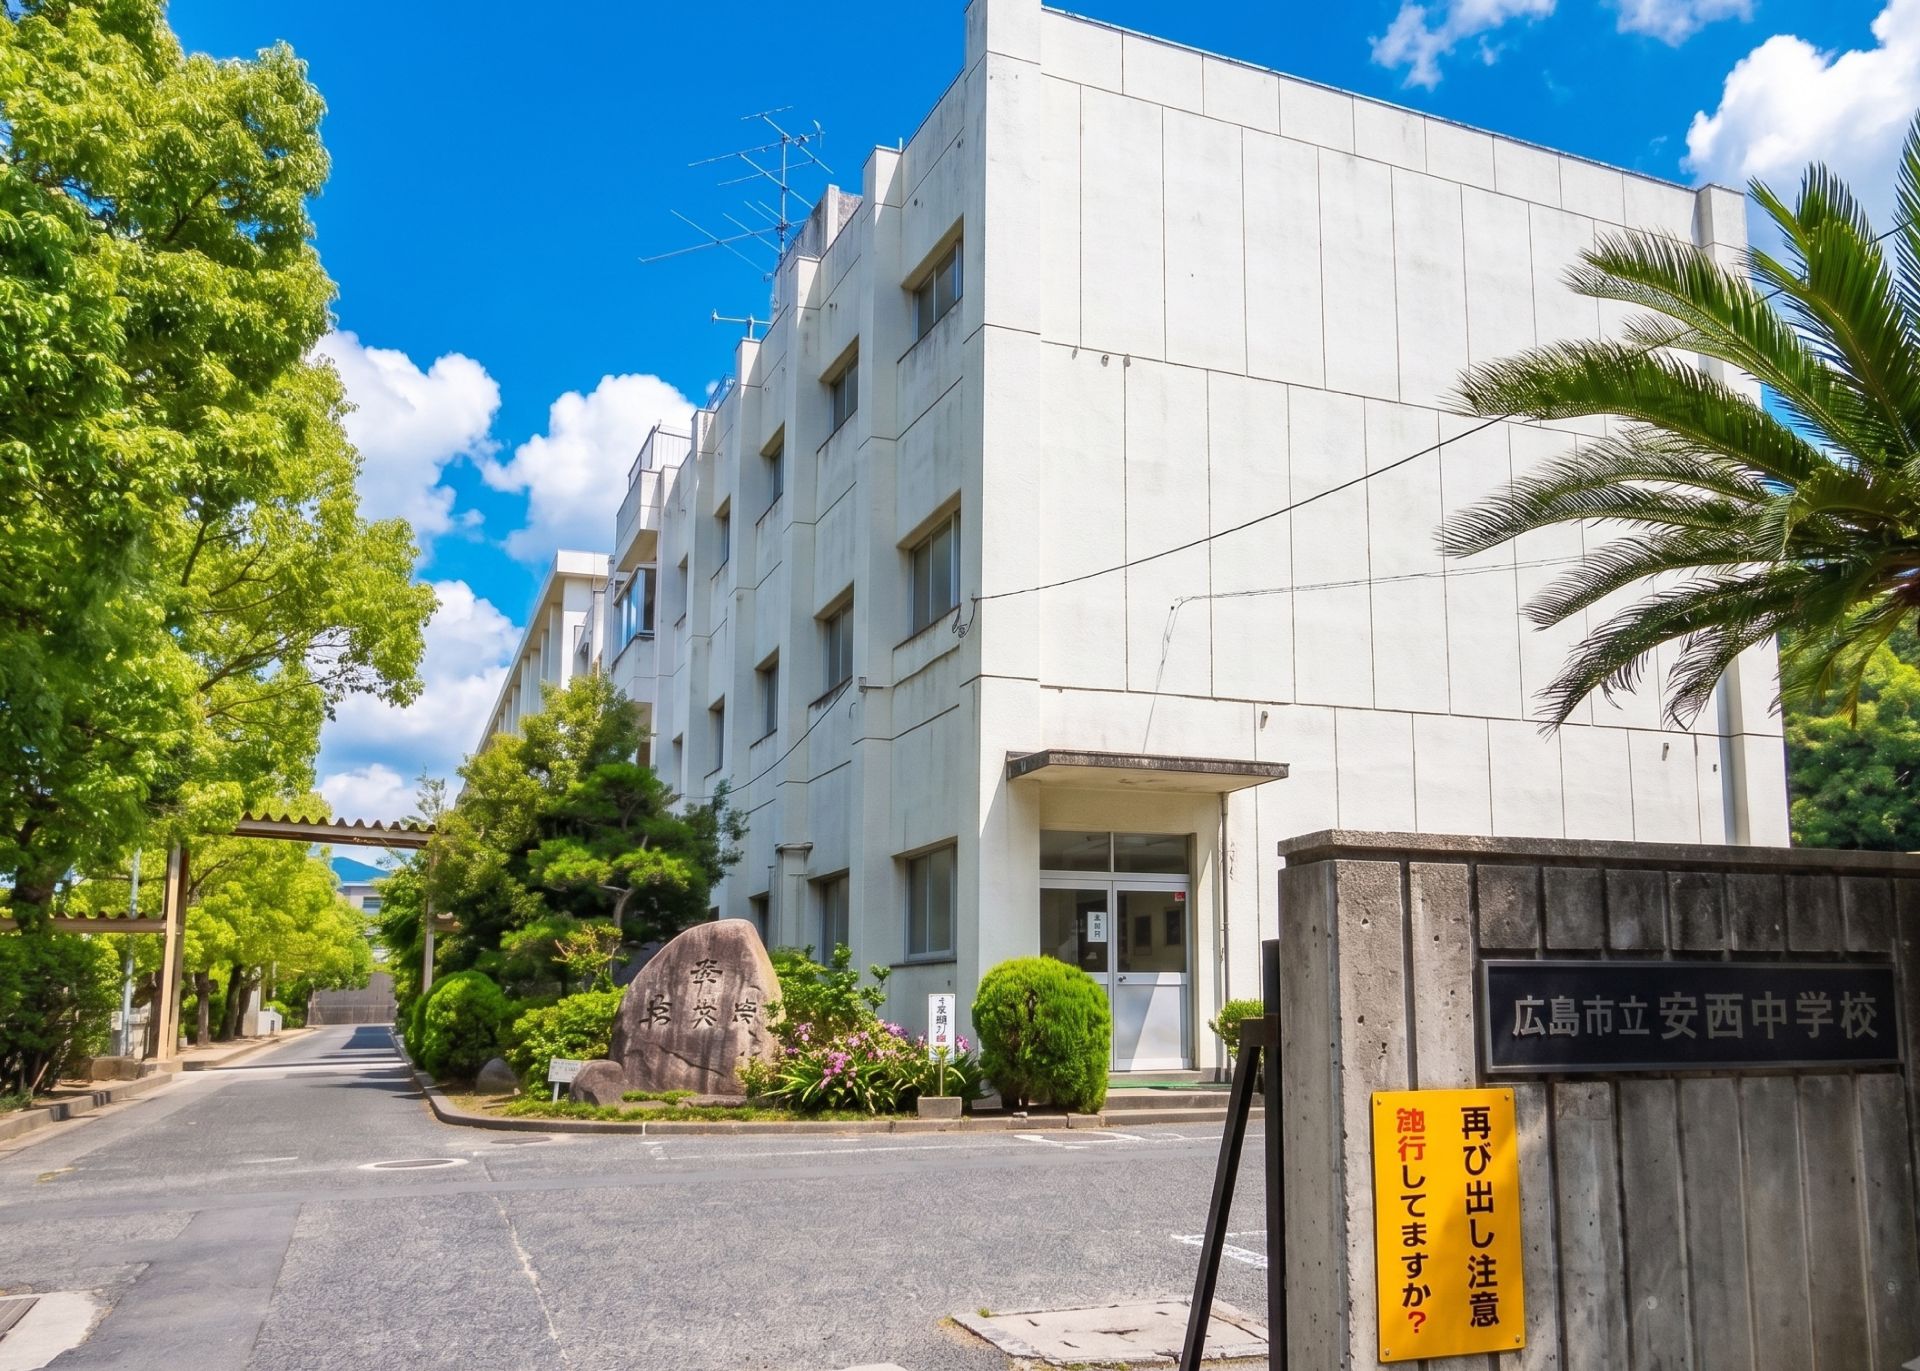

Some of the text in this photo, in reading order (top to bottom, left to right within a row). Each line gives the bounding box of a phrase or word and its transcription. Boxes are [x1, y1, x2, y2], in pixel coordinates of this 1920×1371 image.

[1512, 991, 1878, 1039] 広島市立安西中学校
